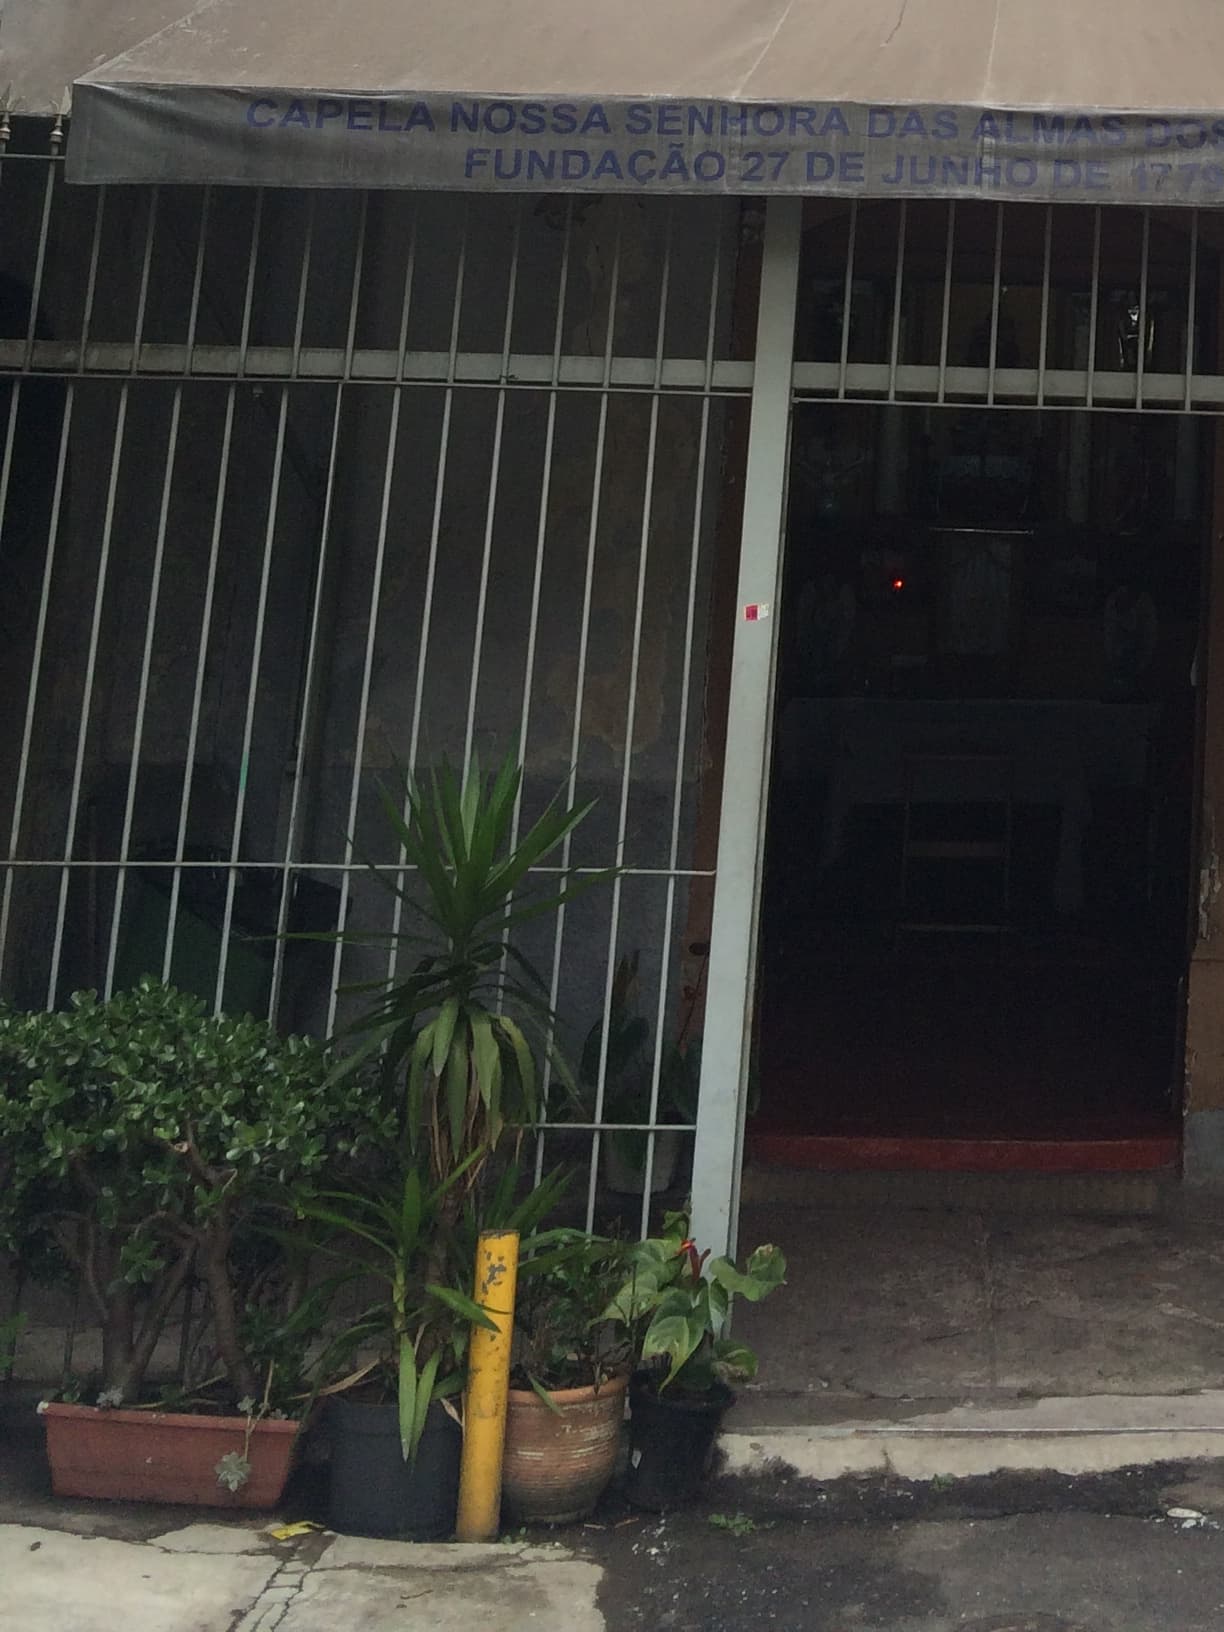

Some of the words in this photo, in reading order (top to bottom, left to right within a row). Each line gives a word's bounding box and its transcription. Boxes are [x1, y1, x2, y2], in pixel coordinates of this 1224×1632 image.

[246, 98, 436, 133] CAPELA
[448, 100, 612, 135] NOSSA
[624, 102, 851, 138] SENHORA
[866, 107, 960, 141] DAS
[971, 110, 1129, 146] ALMAS
[463, 142, 727, 186] FUNDAÇÃO
[740, 150, 791, 183] 27
[805, 150, 866, 184] DE
[881, 153, 1039, 189] JUNHO
[1052, 158, 1112, 190] DE
